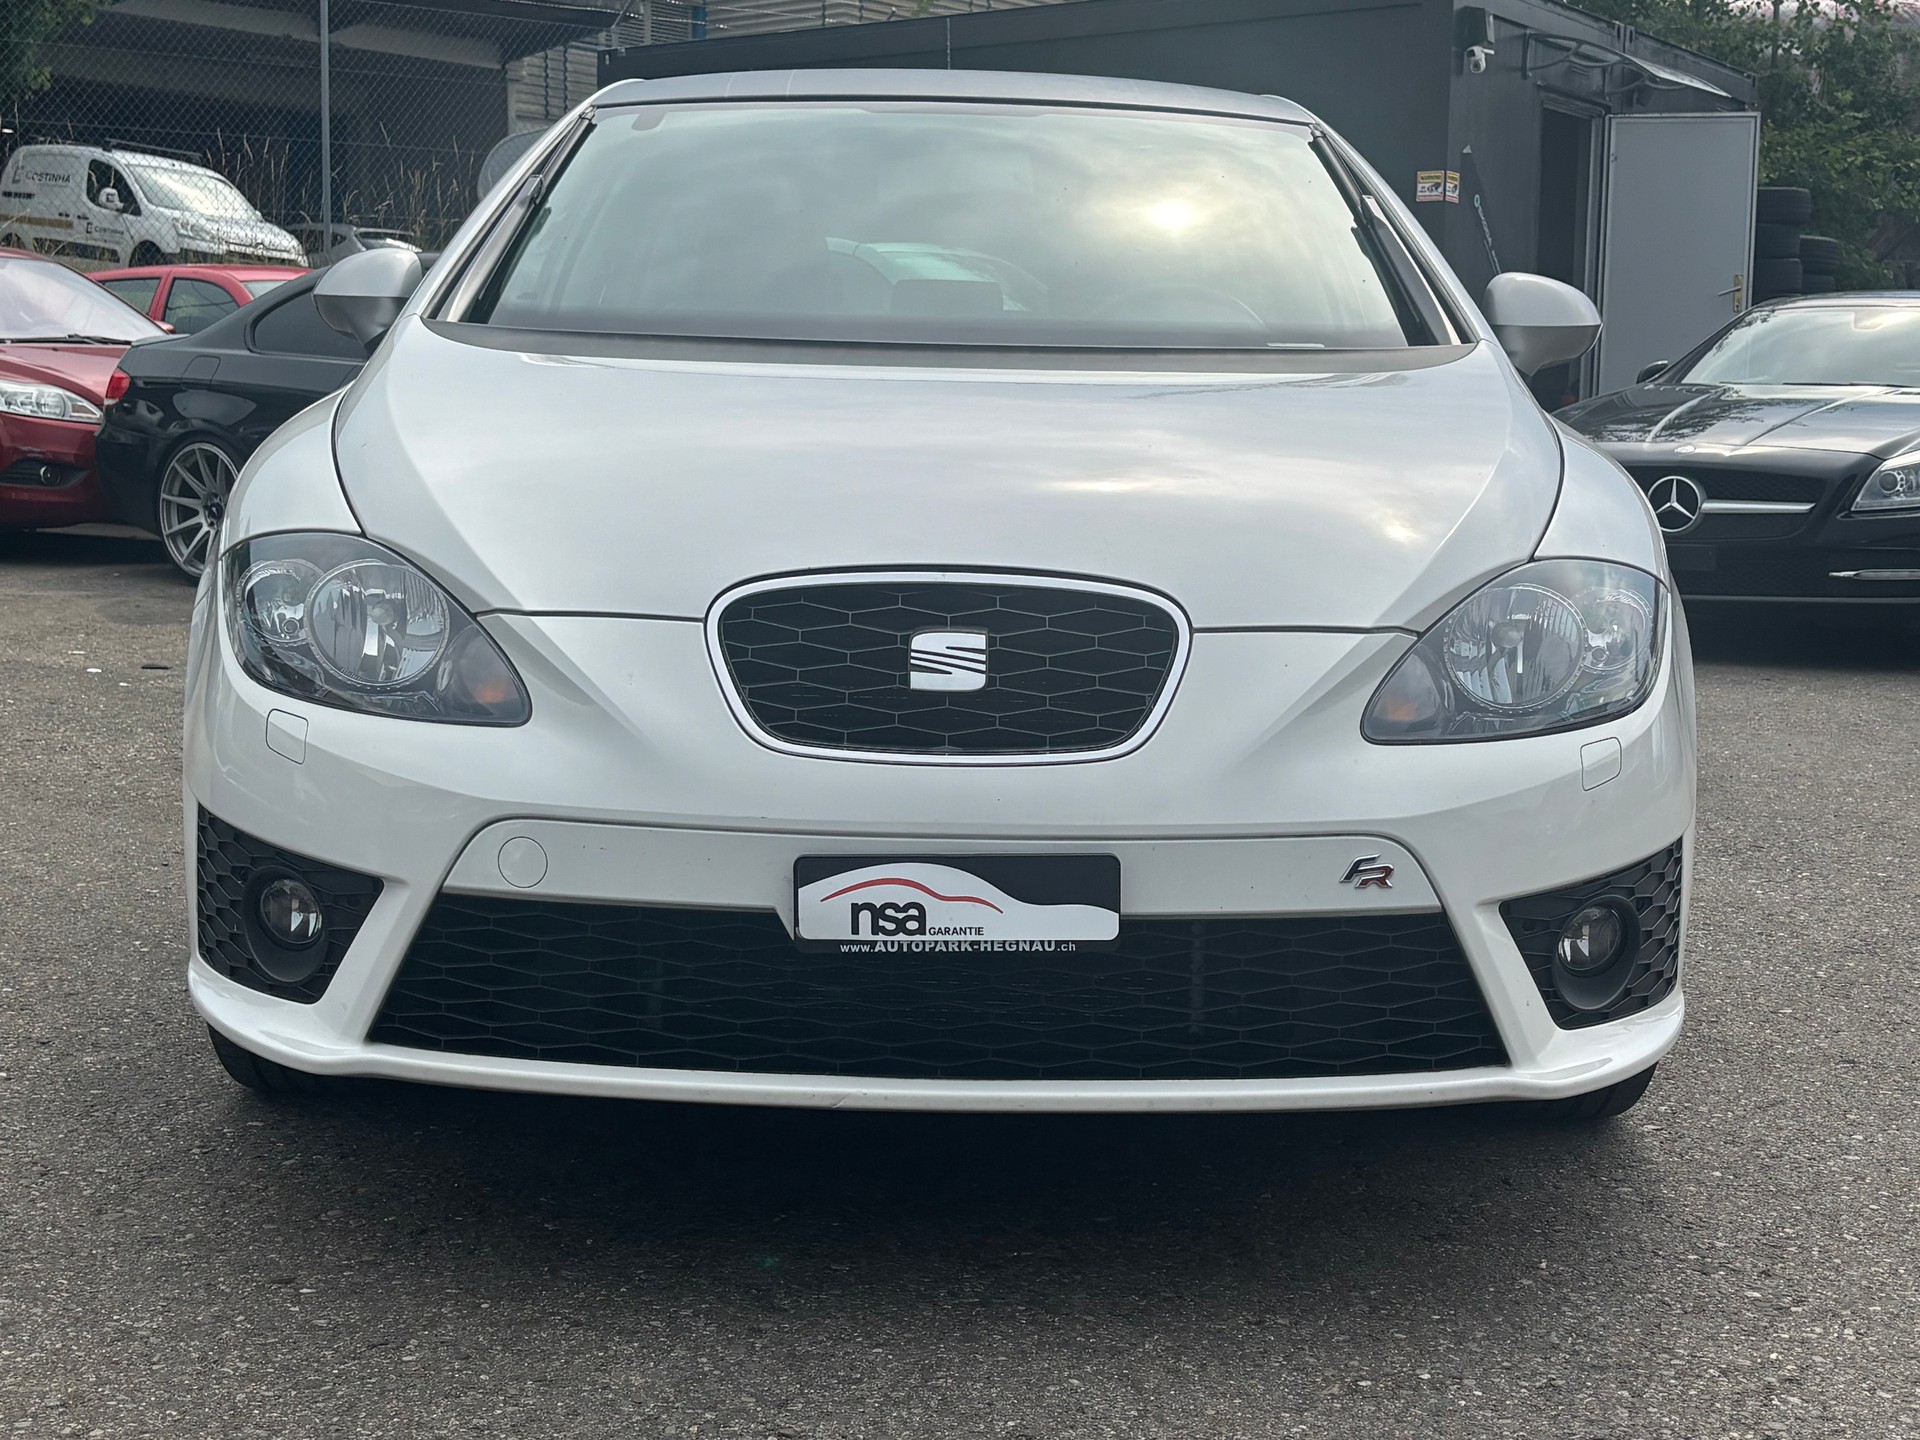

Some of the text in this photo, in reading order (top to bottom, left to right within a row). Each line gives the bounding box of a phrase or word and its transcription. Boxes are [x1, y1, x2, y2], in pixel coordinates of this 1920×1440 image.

[25, 170, 71, 184] COSTINHA
[1339, 853, 1394, 889] FR
[850, 901, 985, 937] nsa GARANTIE
[839, 939, 1077, 953] www.AUTOPARK-HEGNAU.ch
